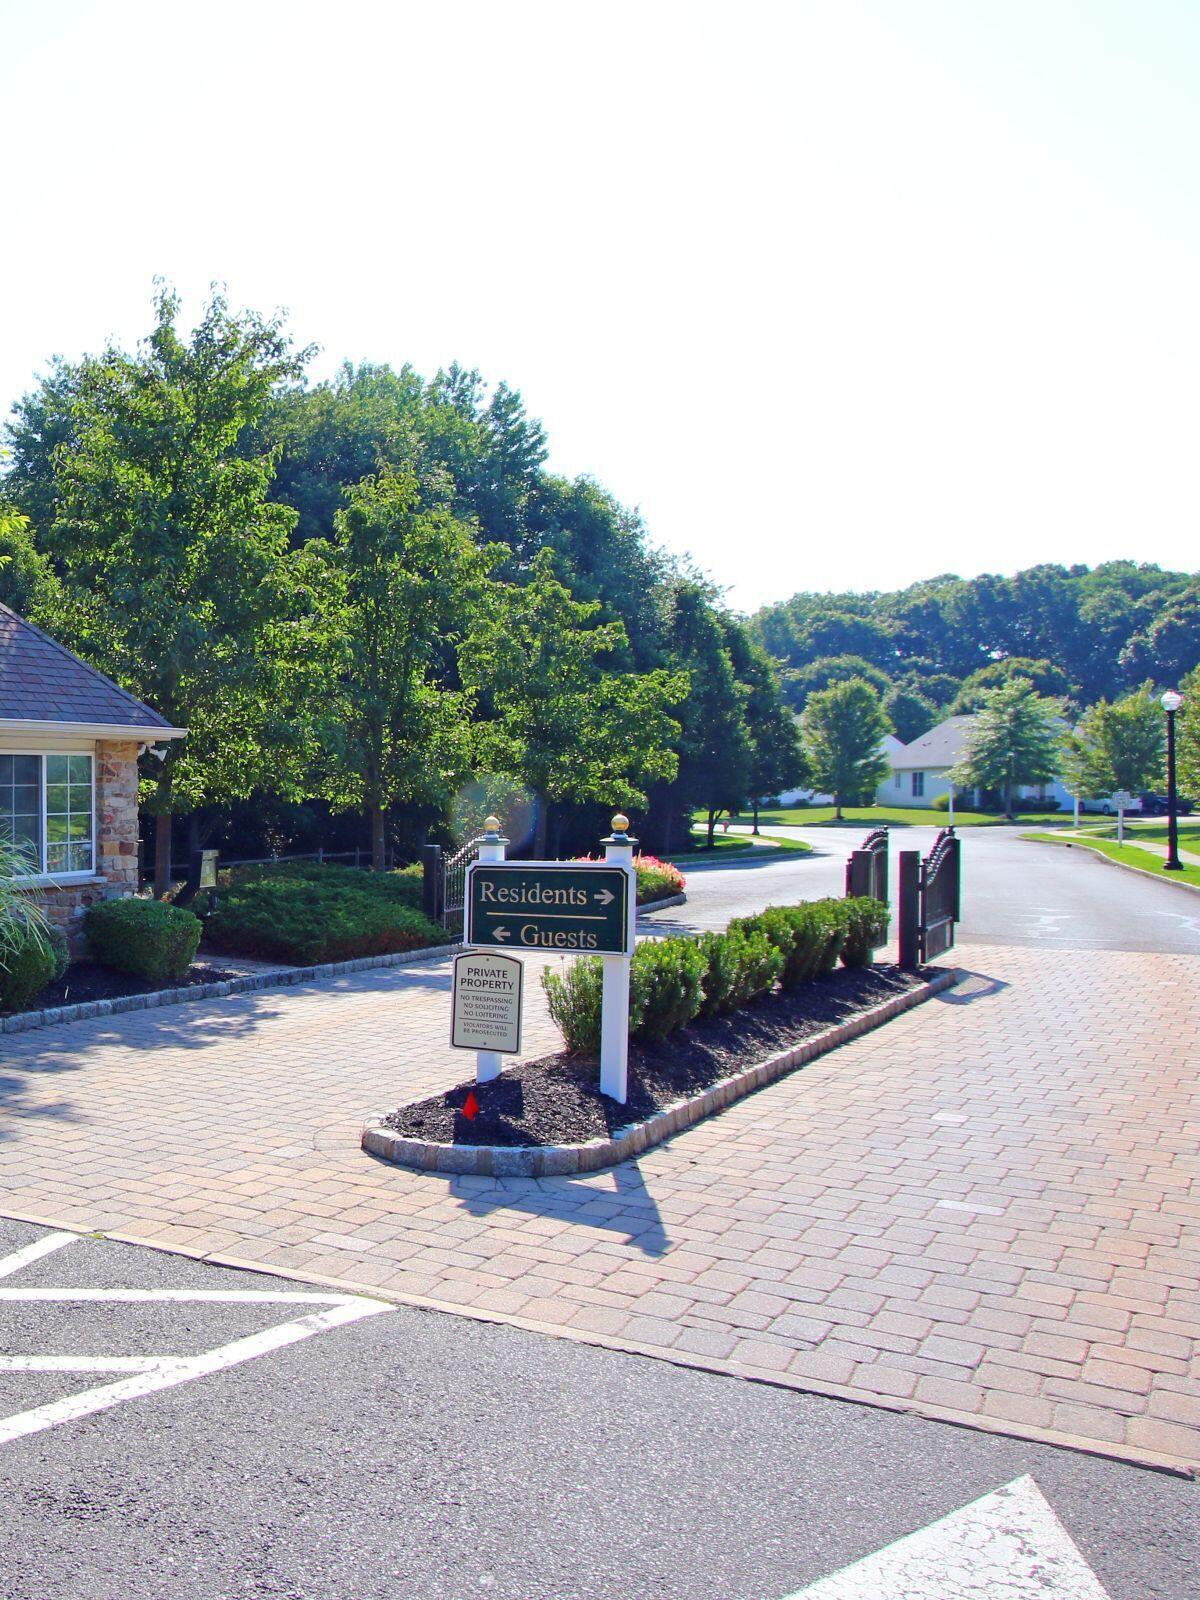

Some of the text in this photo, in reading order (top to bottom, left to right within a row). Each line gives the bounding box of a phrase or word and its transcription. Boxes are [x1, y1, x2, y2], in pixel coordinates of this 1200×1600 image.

[480, 881, 587, 905] Residents
[520, 924, 598, 948] Guests
[467, 968, 508, 978] PRIVATE
[460, 978, 514, 990] PROPERTY
[472, 996, 512, 1004] TRESPASSING
[475, 1004, 508, 1012] SOLICITING
[472, 1028, 508, 1036] PROSECUTED
